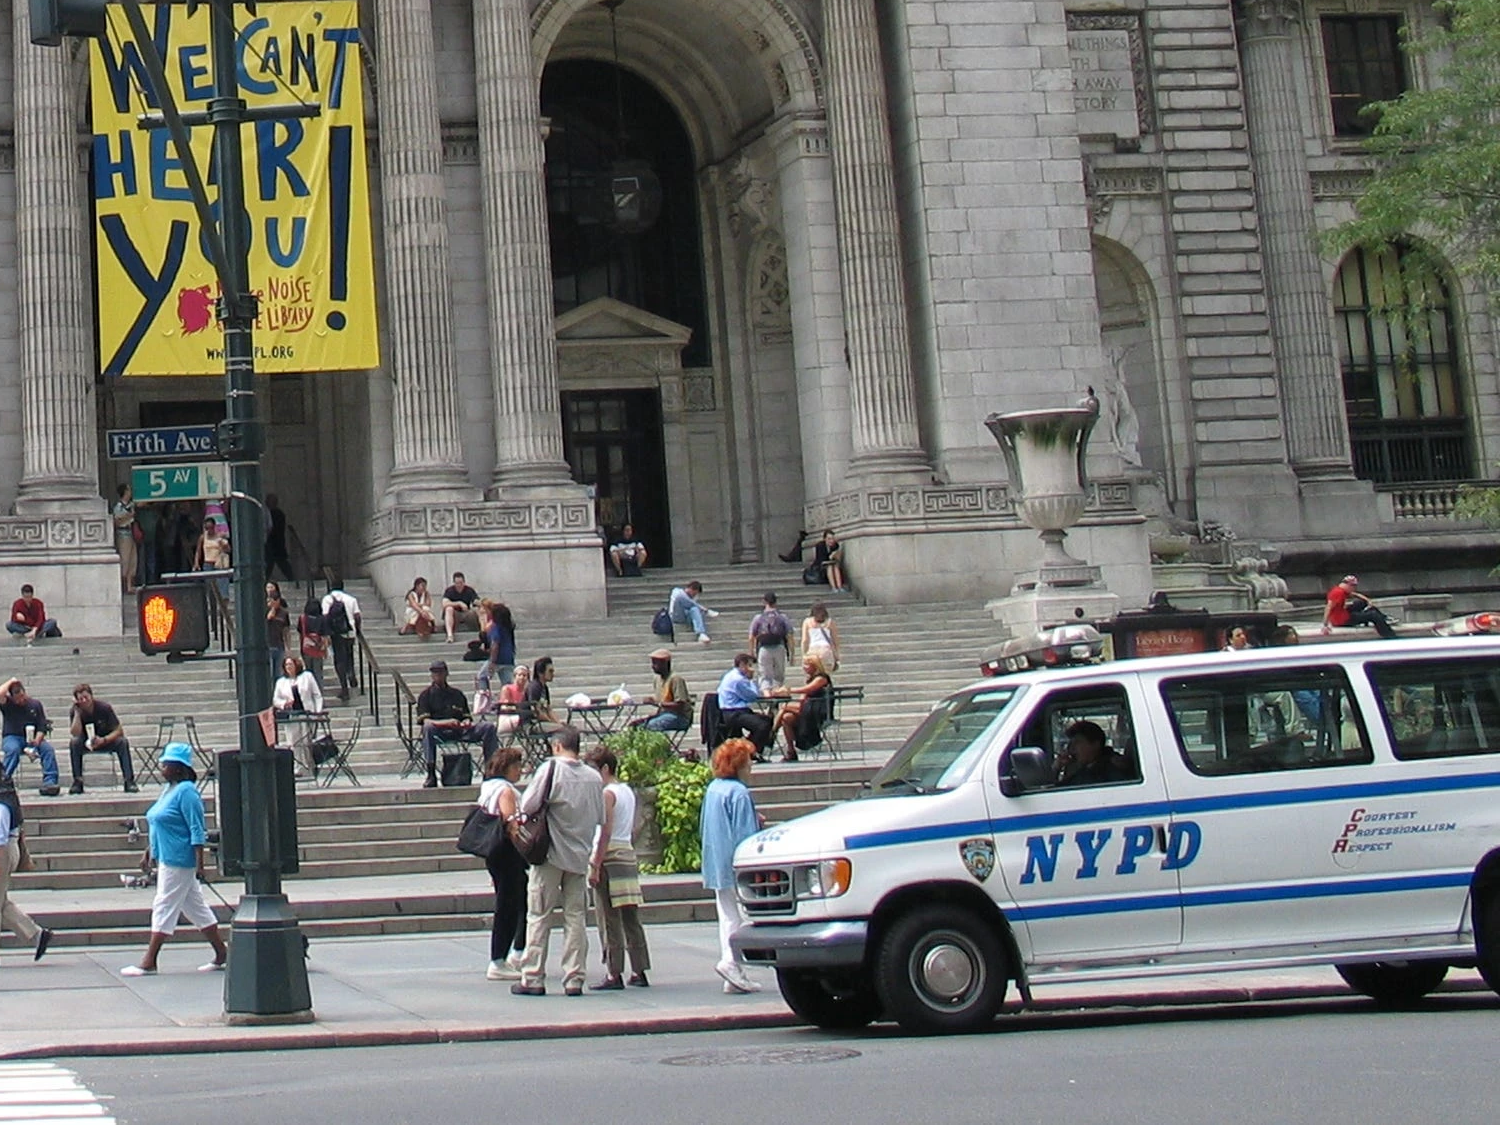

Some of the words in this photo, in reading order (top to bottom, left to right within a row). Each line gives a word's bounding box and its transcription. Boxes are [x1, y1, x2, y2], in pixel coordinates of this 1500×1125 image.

[1084, 77, 1122, 91] AWAY
[1074, 96, 1118, 111] CTORY
[94, 120, 312, 202] HER
[206, 346, 294, 361] WWPL.ORG
[112, 432, 166, 456] Fifth
[150, 470, 167, 497] 5
[173, 469, 191, 483] AV
[1341, 822, 1457, 838] PROFESSIONALISM
[1019, 820, 1202, 885] NYPD
